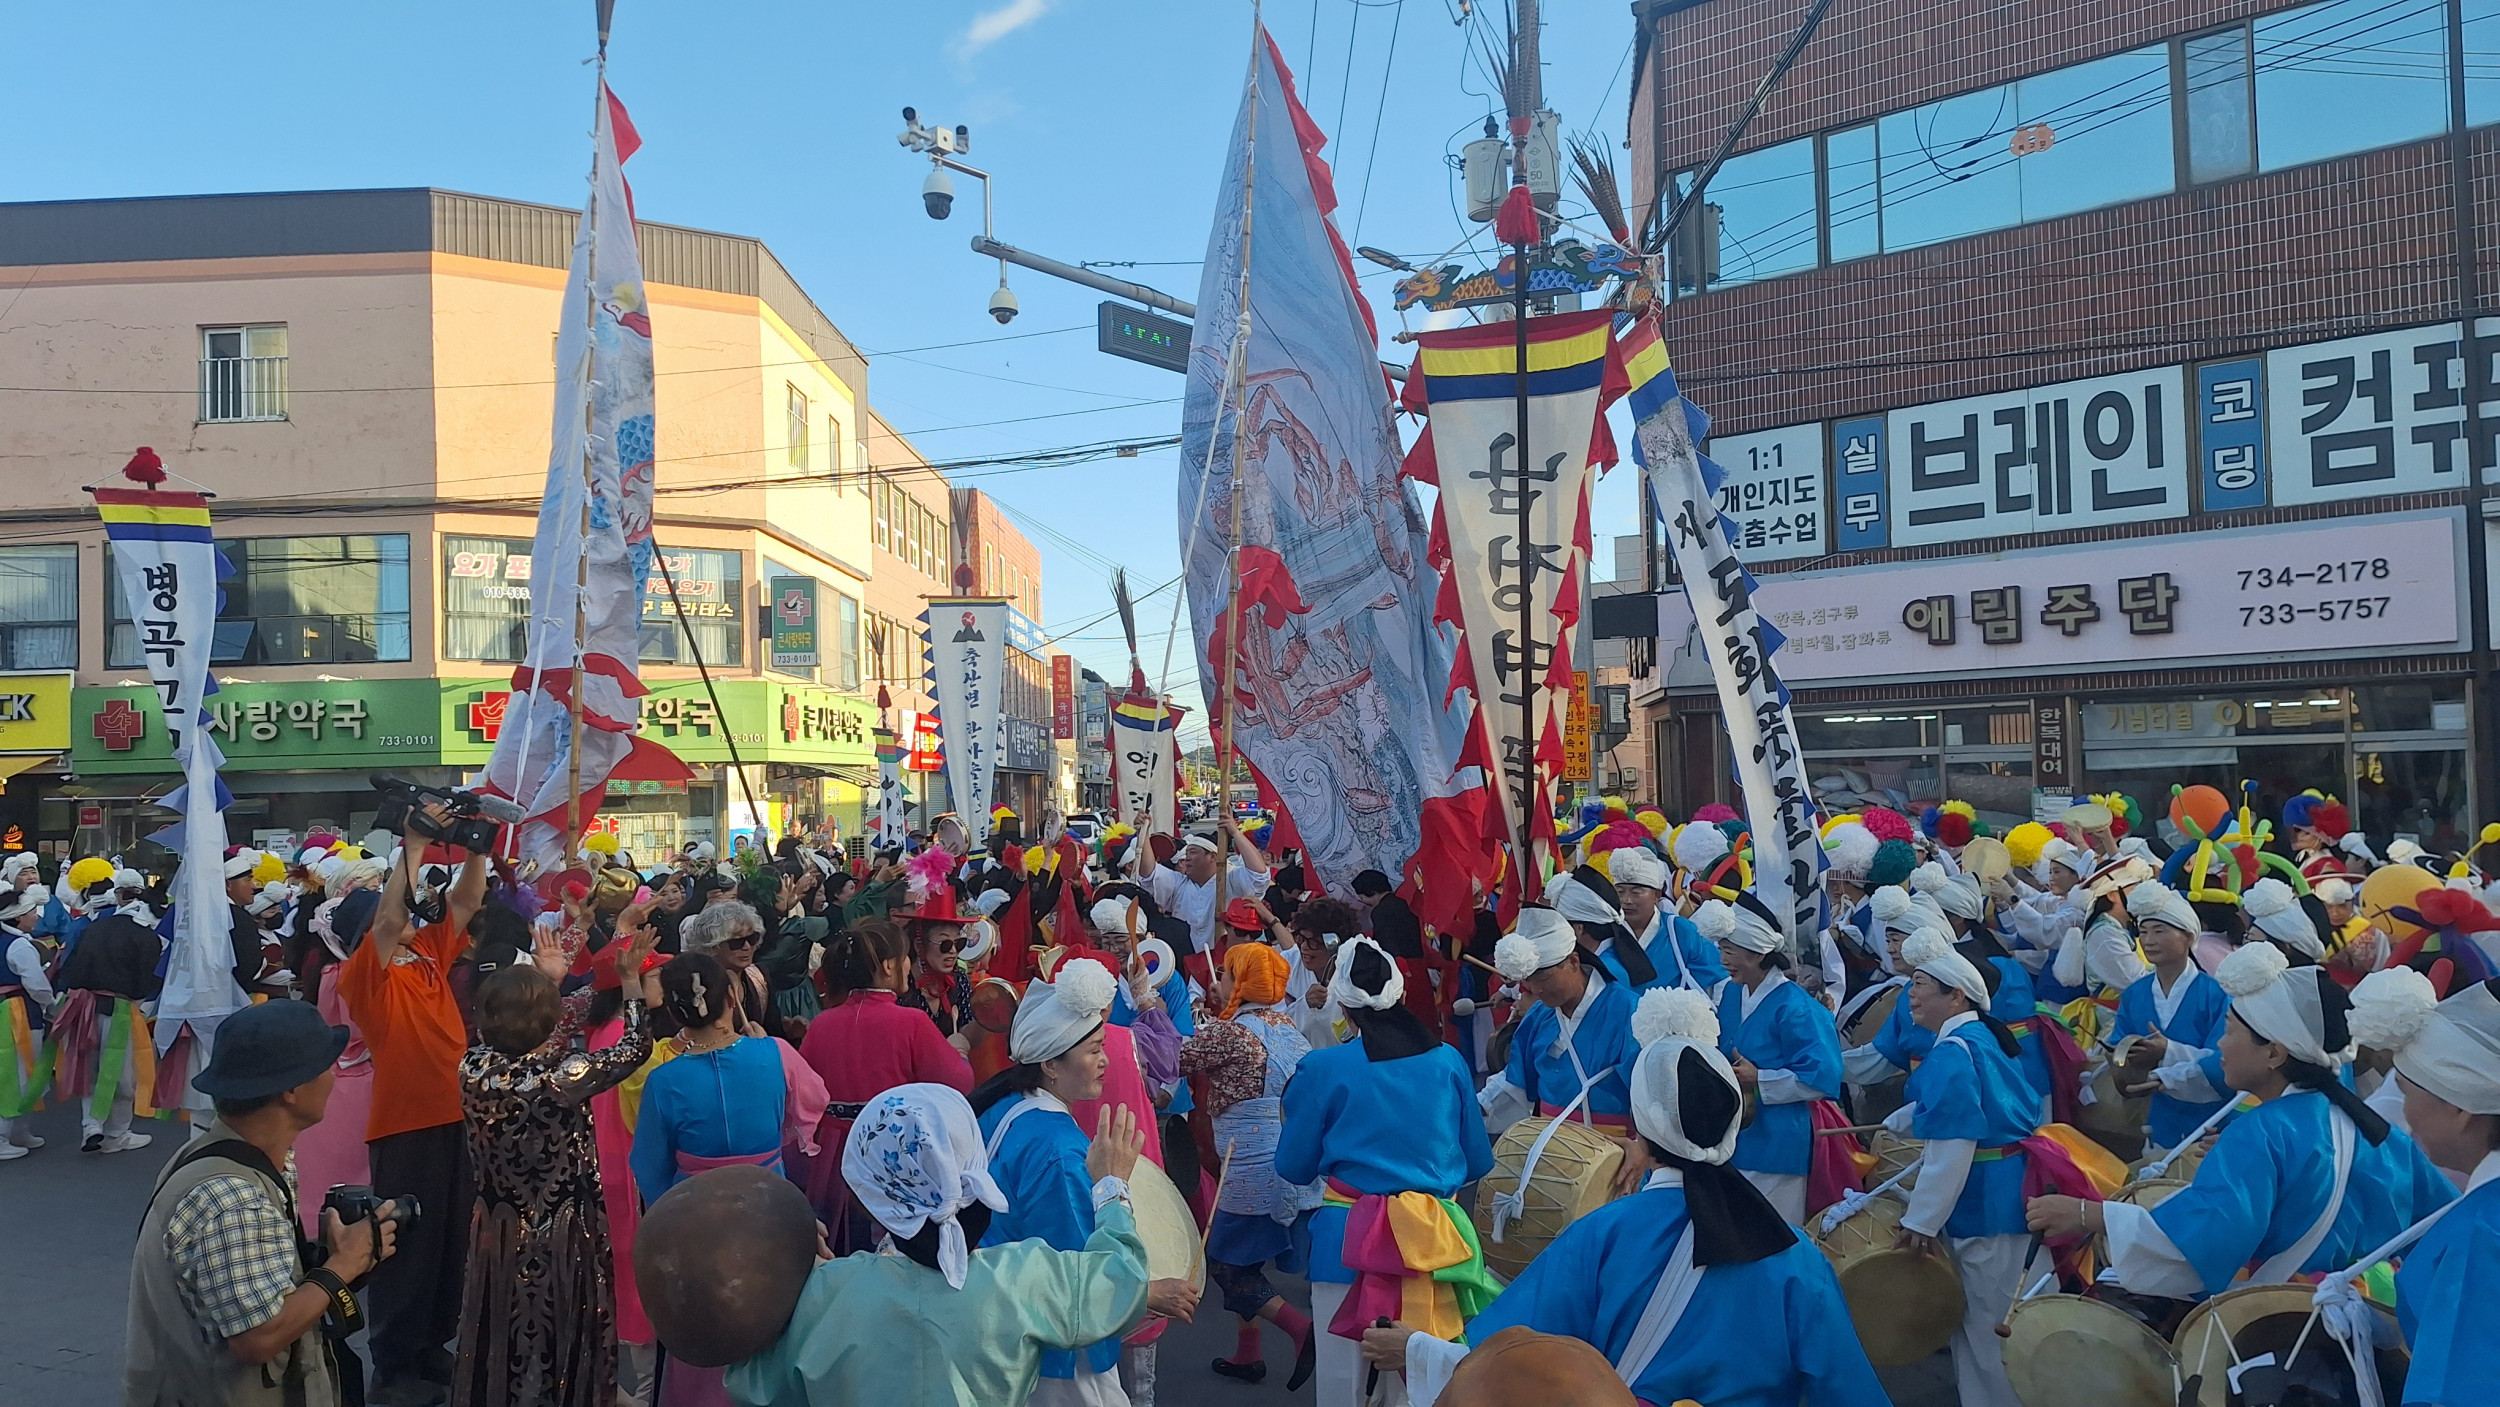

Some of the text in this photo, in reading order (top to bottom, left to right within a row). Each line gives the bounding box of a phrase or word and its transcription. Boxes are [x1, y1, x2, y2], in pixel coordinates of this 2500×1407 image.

[2209, 378, 2258, 490] 코딩
[1748, 443, 1783, 471] 1:1
[1909, 384, 2167, 526] 브레인
[1720, 475, 1816, 512] 개인지도
[1843, 434, 1880, 532] 실무
[451, 552, 532, 579] 요가 포
[2238, 558, 2391, 590] 734-2178
[483, 586, 531, 599] 010-585
[677, 580, 715, 596] 요가
[660, 602, 735, 617] 필라테스
[1903, 573, 2179, 645] 애림주단
[2240, 597, 2391, 627] 733-5757
[778, 632, 812, 649] 큰사랑약국
[777, 655, 812, 664] 733-0101
[803, 705, 863, 743] 큰사랑약국
[2106, 702, 2193, 733] 기념타월
[379, 735, 434, 746] 733-0101
[2040, 707, 2062, 774] 한복대여
[337, 1288, 356, 1317] Nikon
